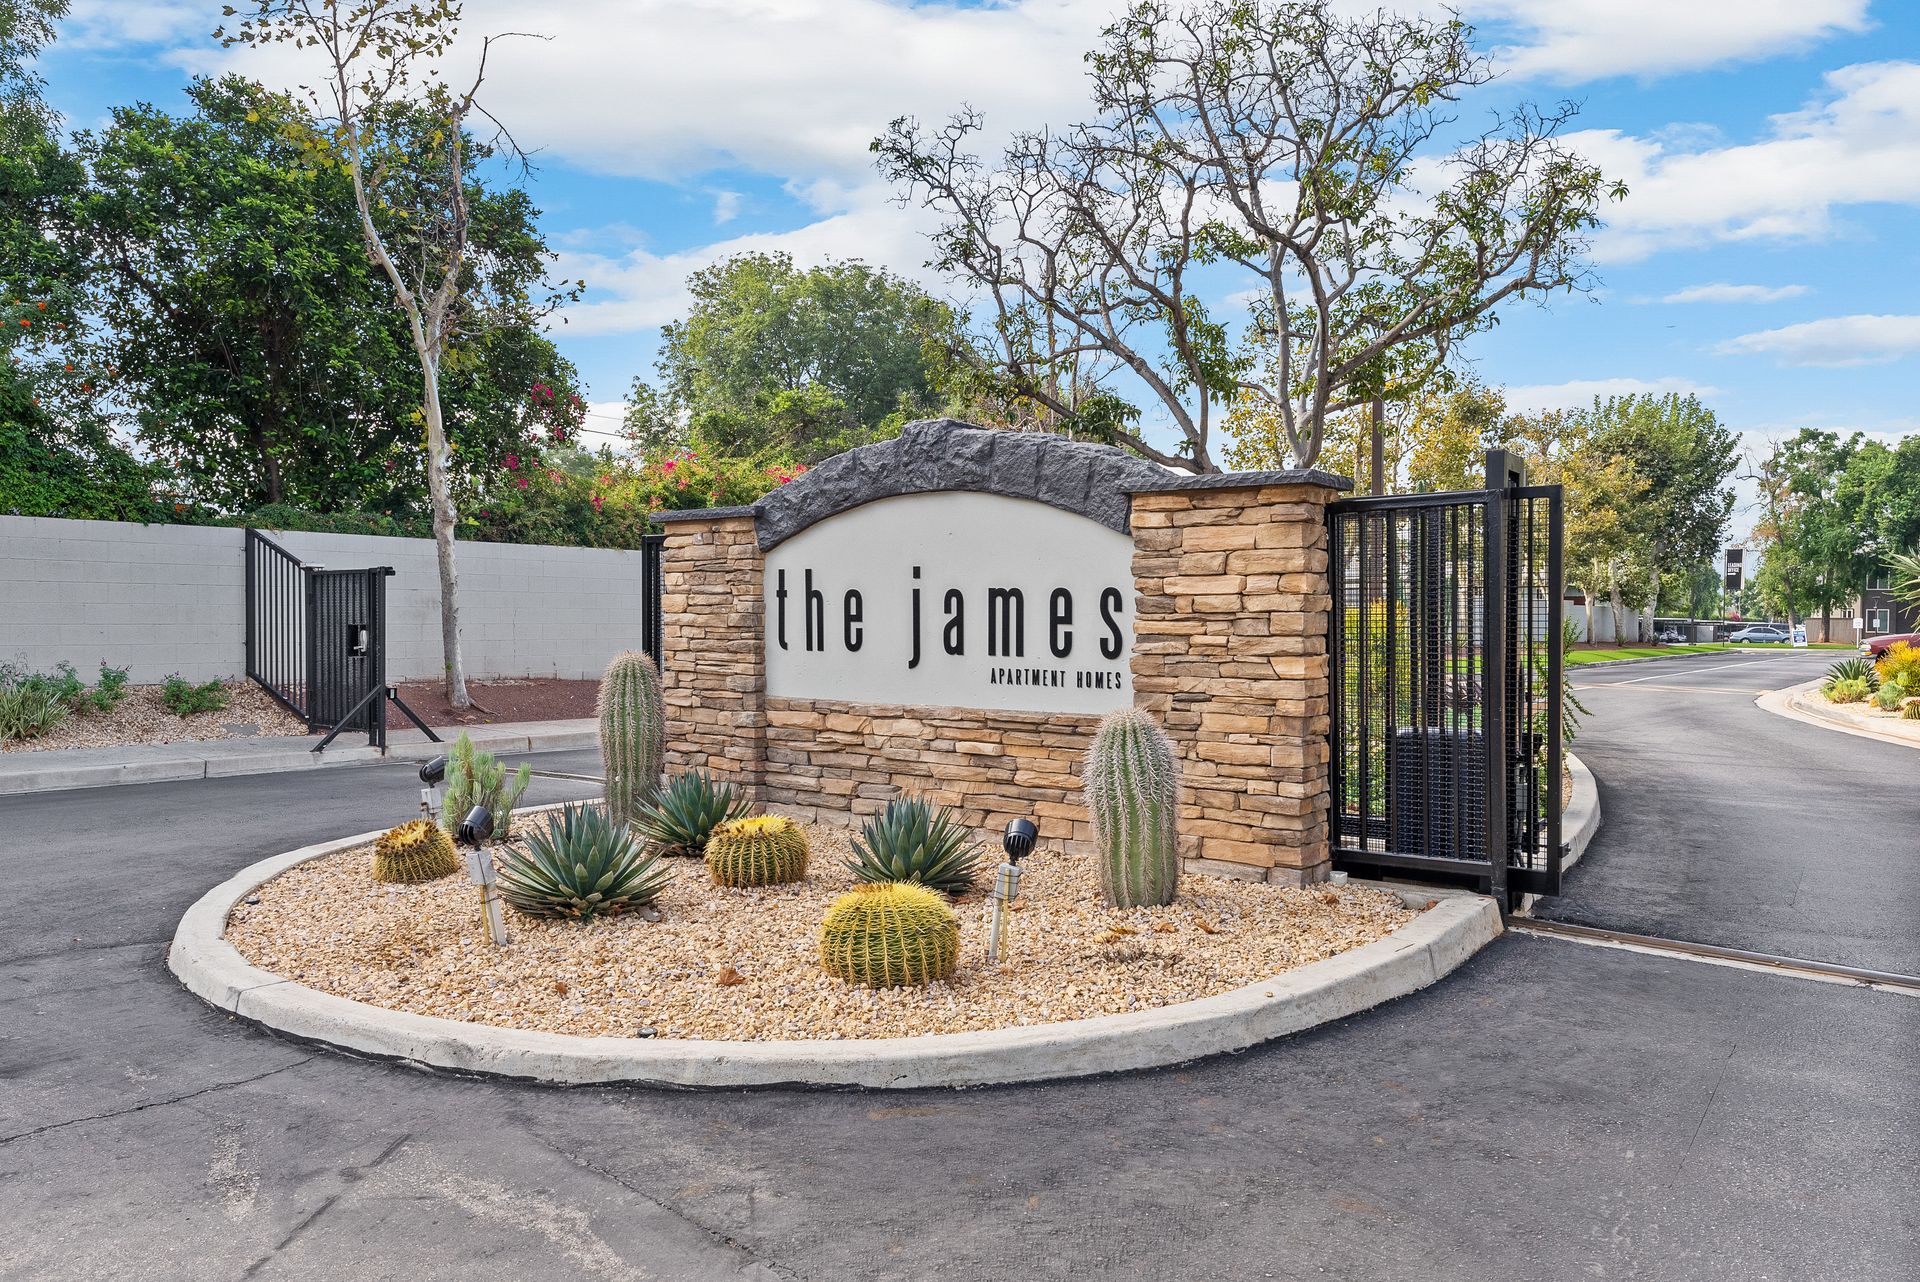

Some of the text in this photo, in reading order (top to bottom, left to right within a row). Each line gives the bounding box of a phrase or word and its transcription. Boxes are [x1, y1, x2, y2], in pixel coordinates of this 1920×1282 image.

[775, 565, 1124, 670] the james
[990, 667, 1122, 690] APARTMENT HOMES
